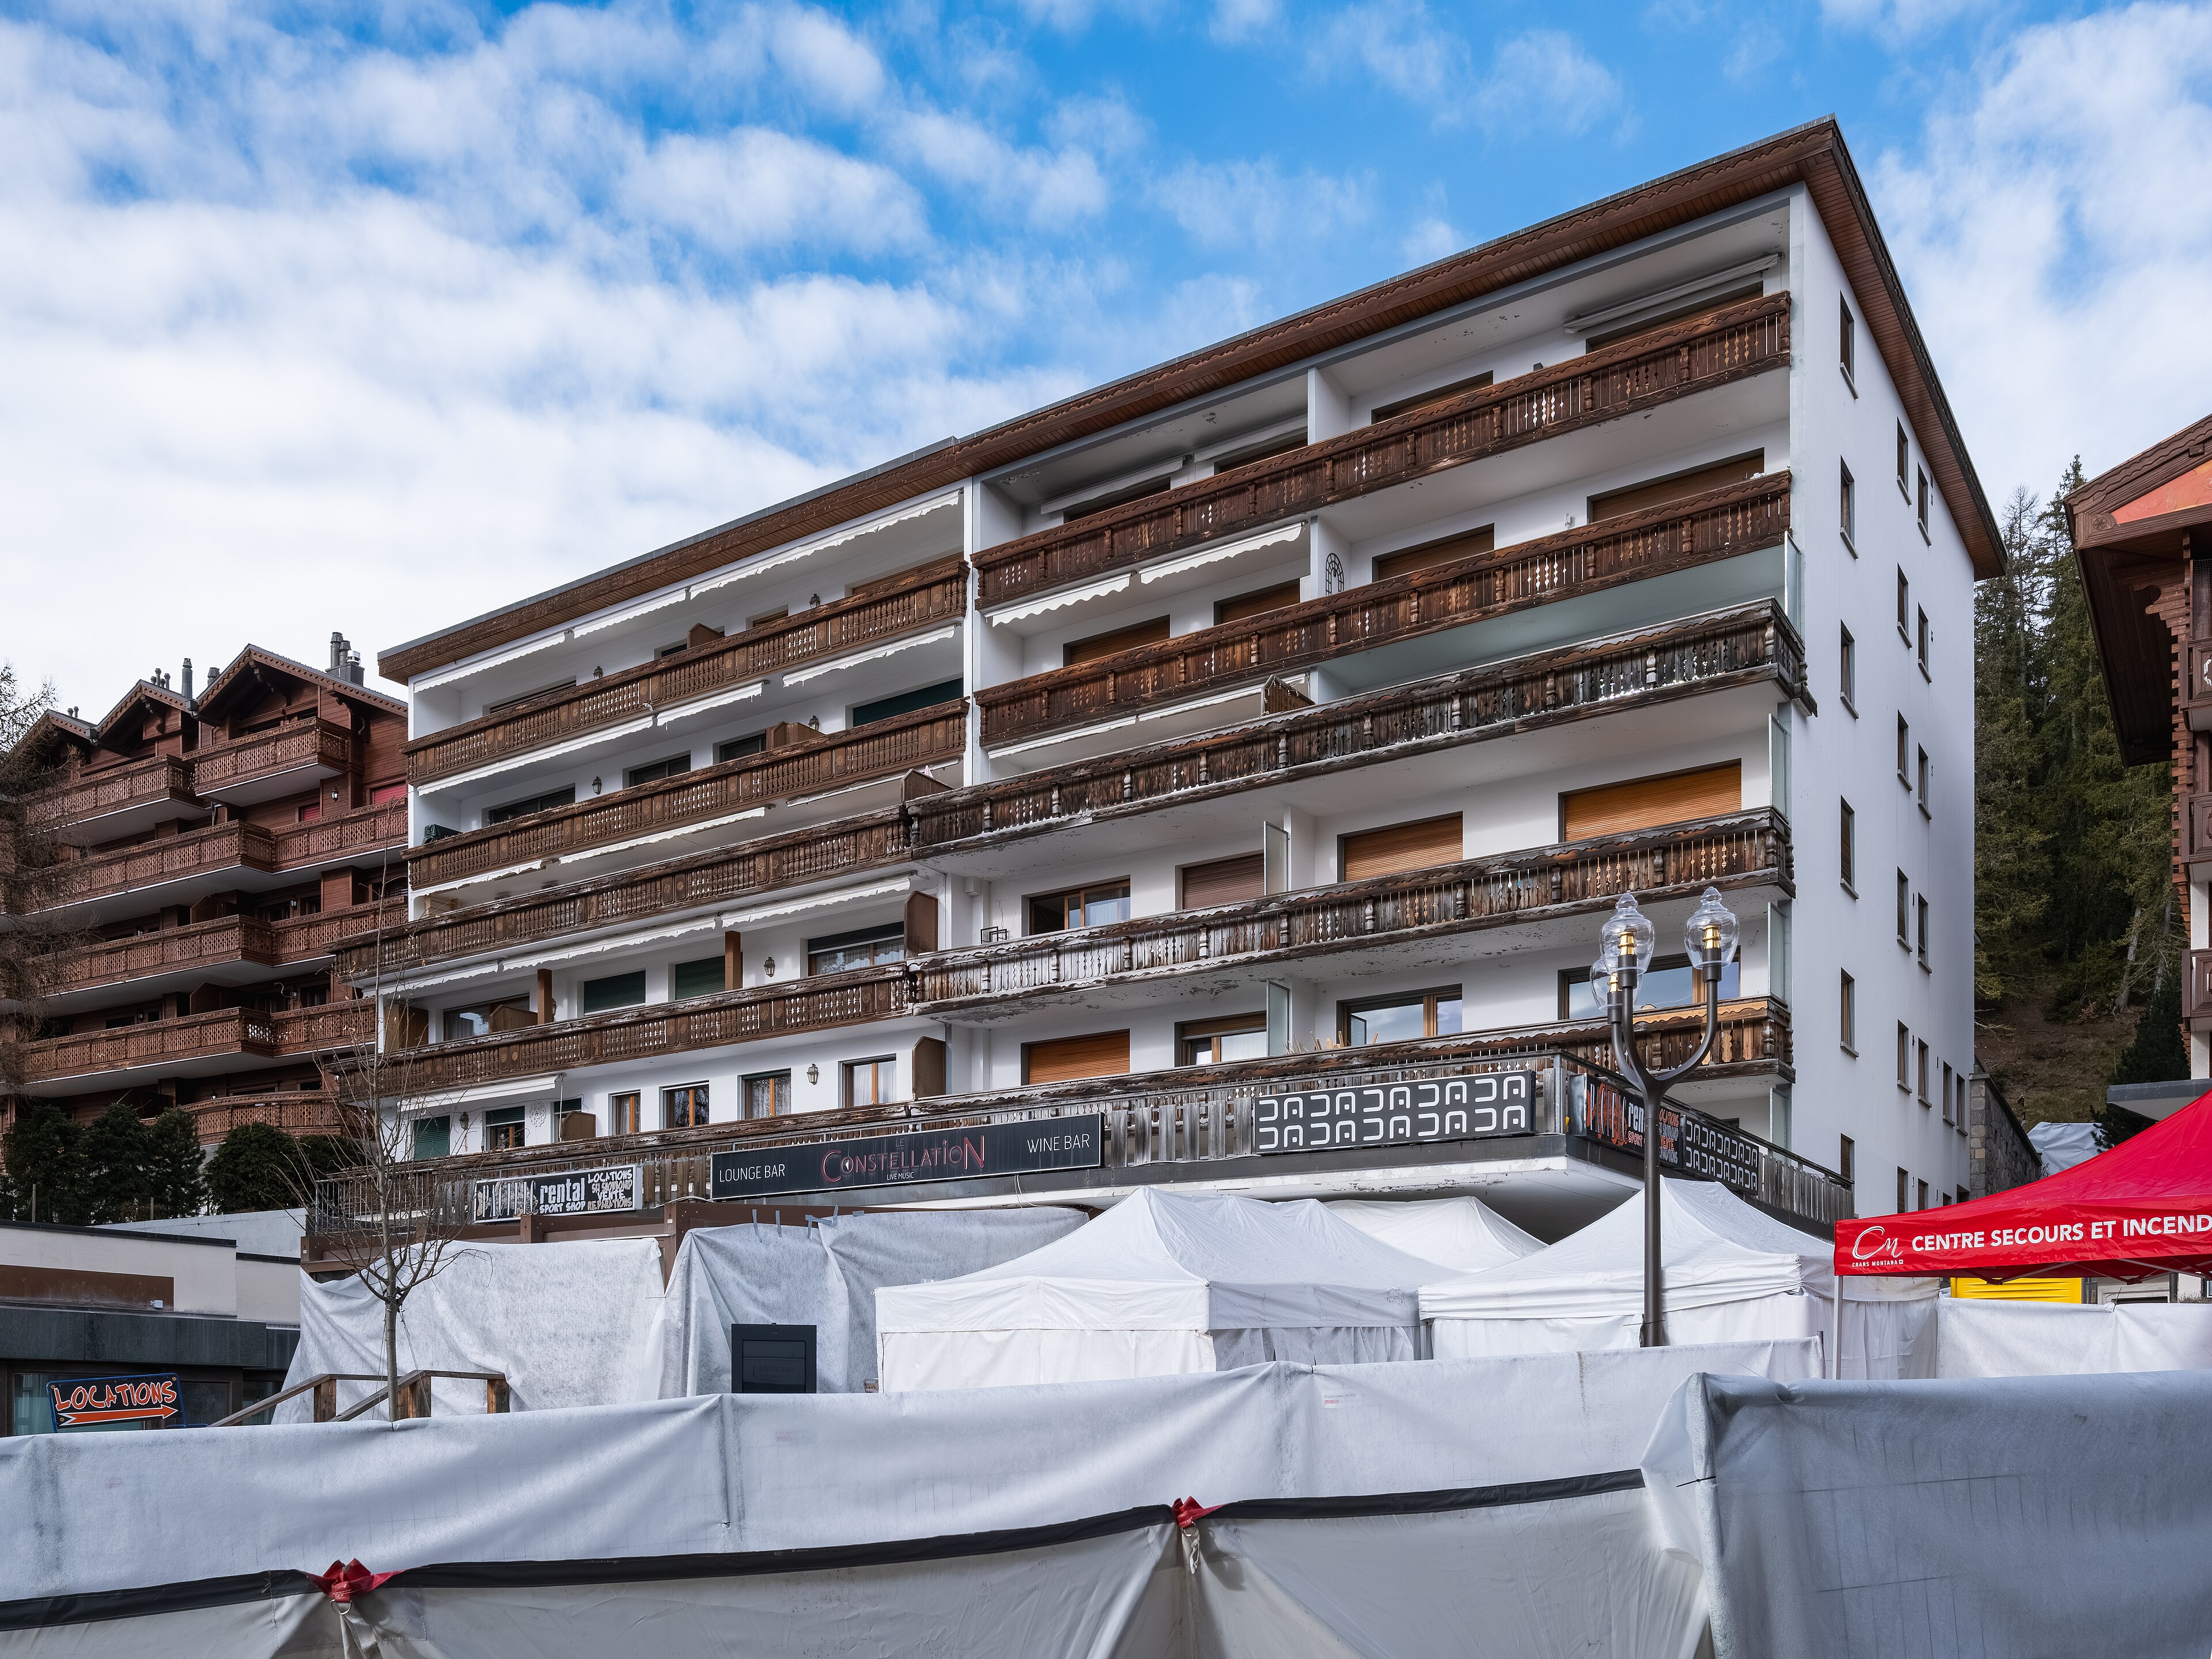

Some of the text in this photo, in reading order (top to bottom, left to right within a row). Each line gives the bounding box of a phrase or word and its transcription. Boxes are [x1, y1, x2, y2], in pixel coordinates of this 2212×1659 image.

[896, 1138, 905, 1147] LE
[1027, 1134, 1089, 1153] WINE BAR
[1628, 1131, 1643, 1147] SPORT
[1660, 1135, 1675, 1151] VENTE
[821, 1135, 984, 1182] CONSTELLATION
[588, 1169, 632, 1184] LOCATIONS
[719, 1164, 785, 1182] LOUNGE BAR
[898, 1172, 914, 1180] MUSIC
[482, 1180, 536, 1217] PACIFIC
[540, 1178, 585, 1205] rental
[597, 1188, 625, 1201] VENTE
[540, 1201, 586, 1214] SPORT SHOP
[1912, 1231, 1984, 1251] CENTRE
[1990, 1223, 2084, 1247] SECOURS
[2091, 1221, 2116, 1239] ET
[54, 1381, 177, 1411] LOCATIONS
